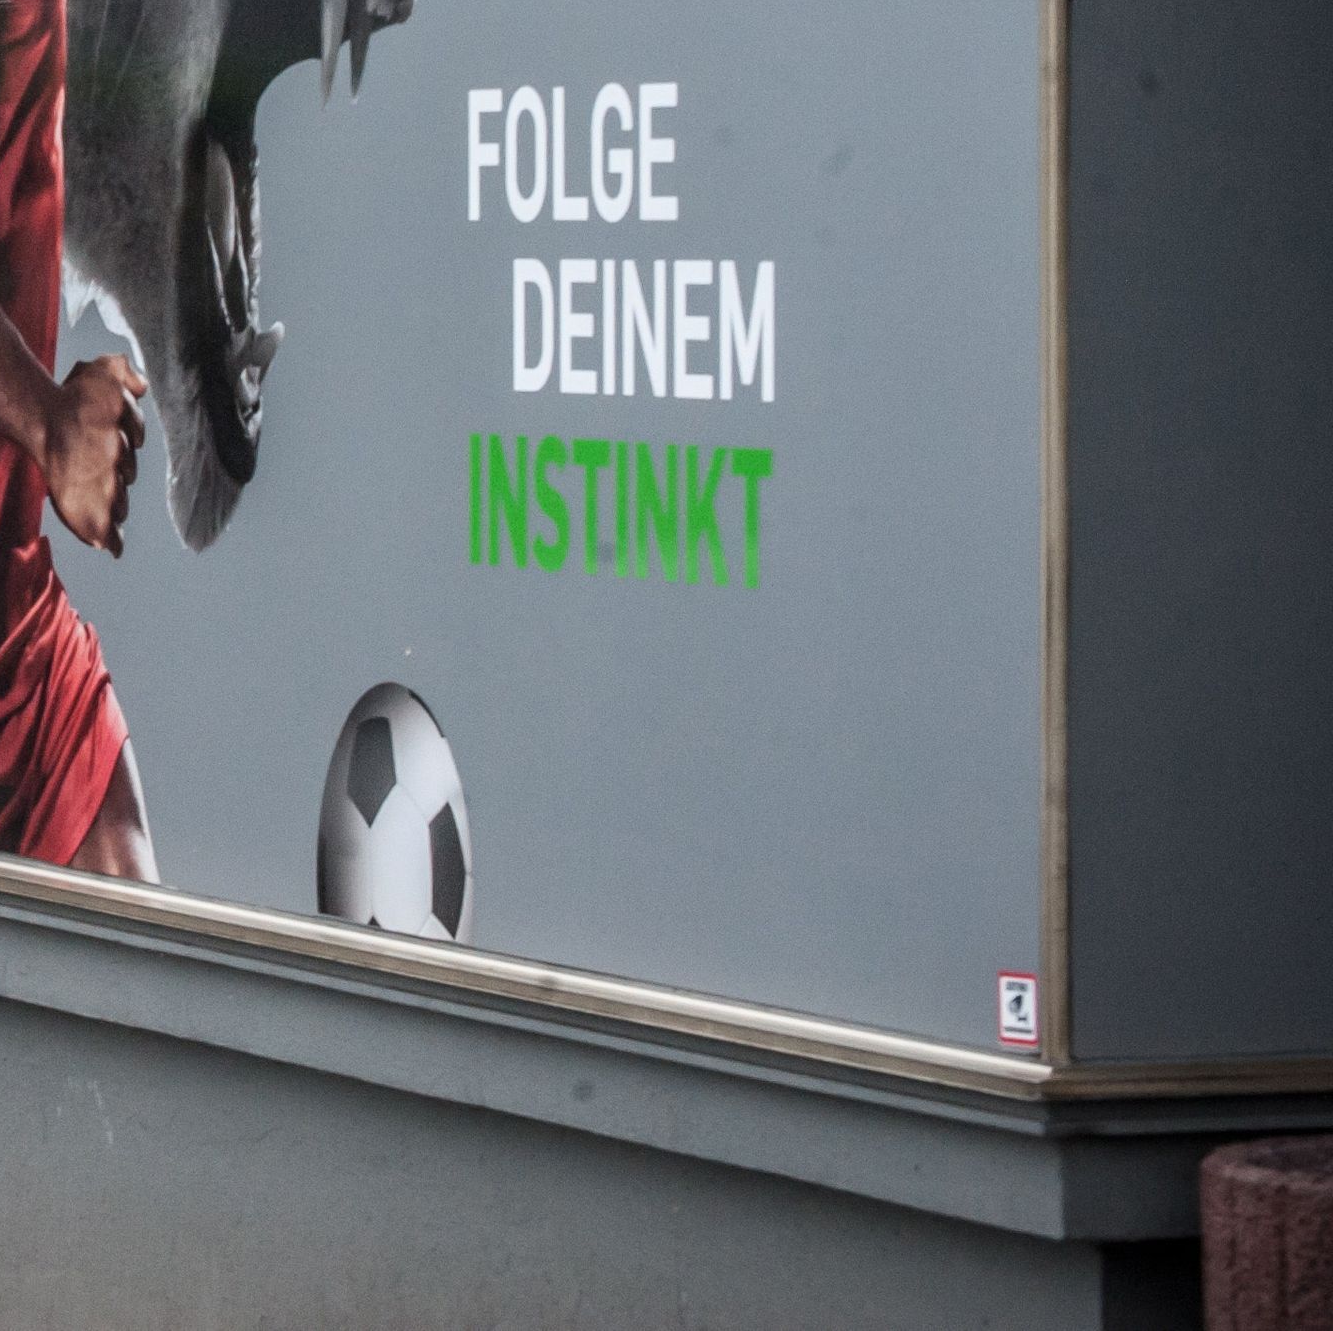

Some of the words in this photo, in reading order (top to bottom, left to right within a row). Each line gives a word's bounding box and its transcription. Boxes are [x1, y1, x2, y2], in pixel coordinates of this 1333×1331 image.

[467, 82, 679, 224] FOLGE
[512, 258, 776, 402] DEINEM
[468, 433, 774, 589] INSTINKT
